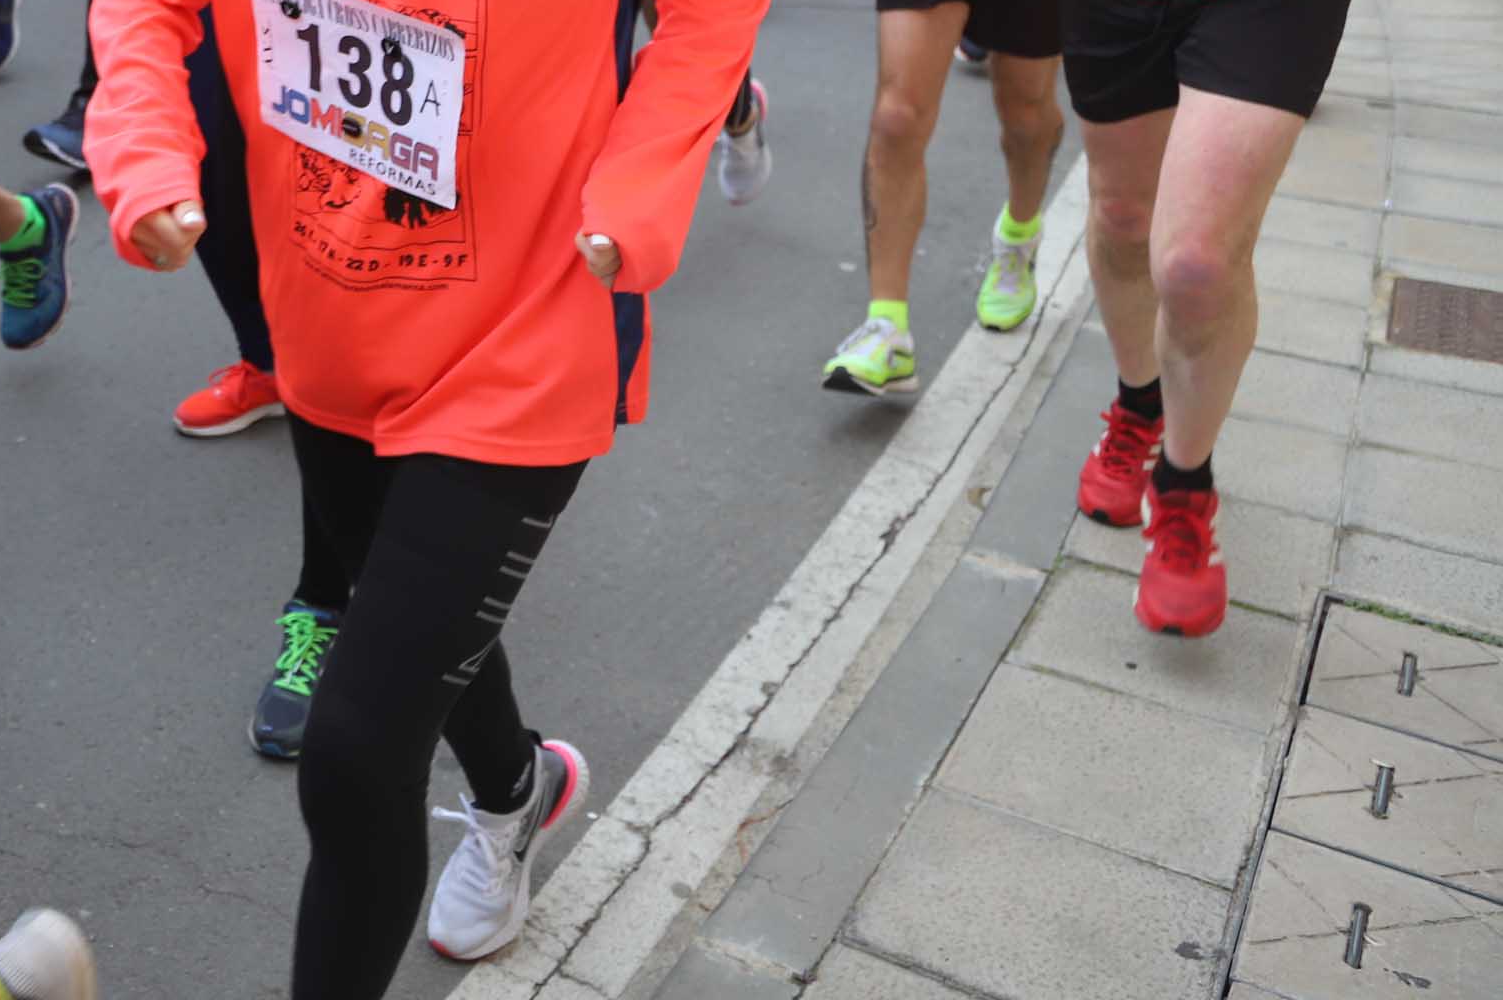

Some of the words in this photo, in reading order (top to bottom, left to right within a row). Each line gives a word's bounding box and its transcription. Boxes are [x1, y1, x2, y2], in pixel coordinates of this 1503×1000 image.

[296, 22, 415, 127] 138
[419, 79, 442, 117] A
[348, 147, 437, 197] REFORMAS
[398, 253, 415, 268] 19
